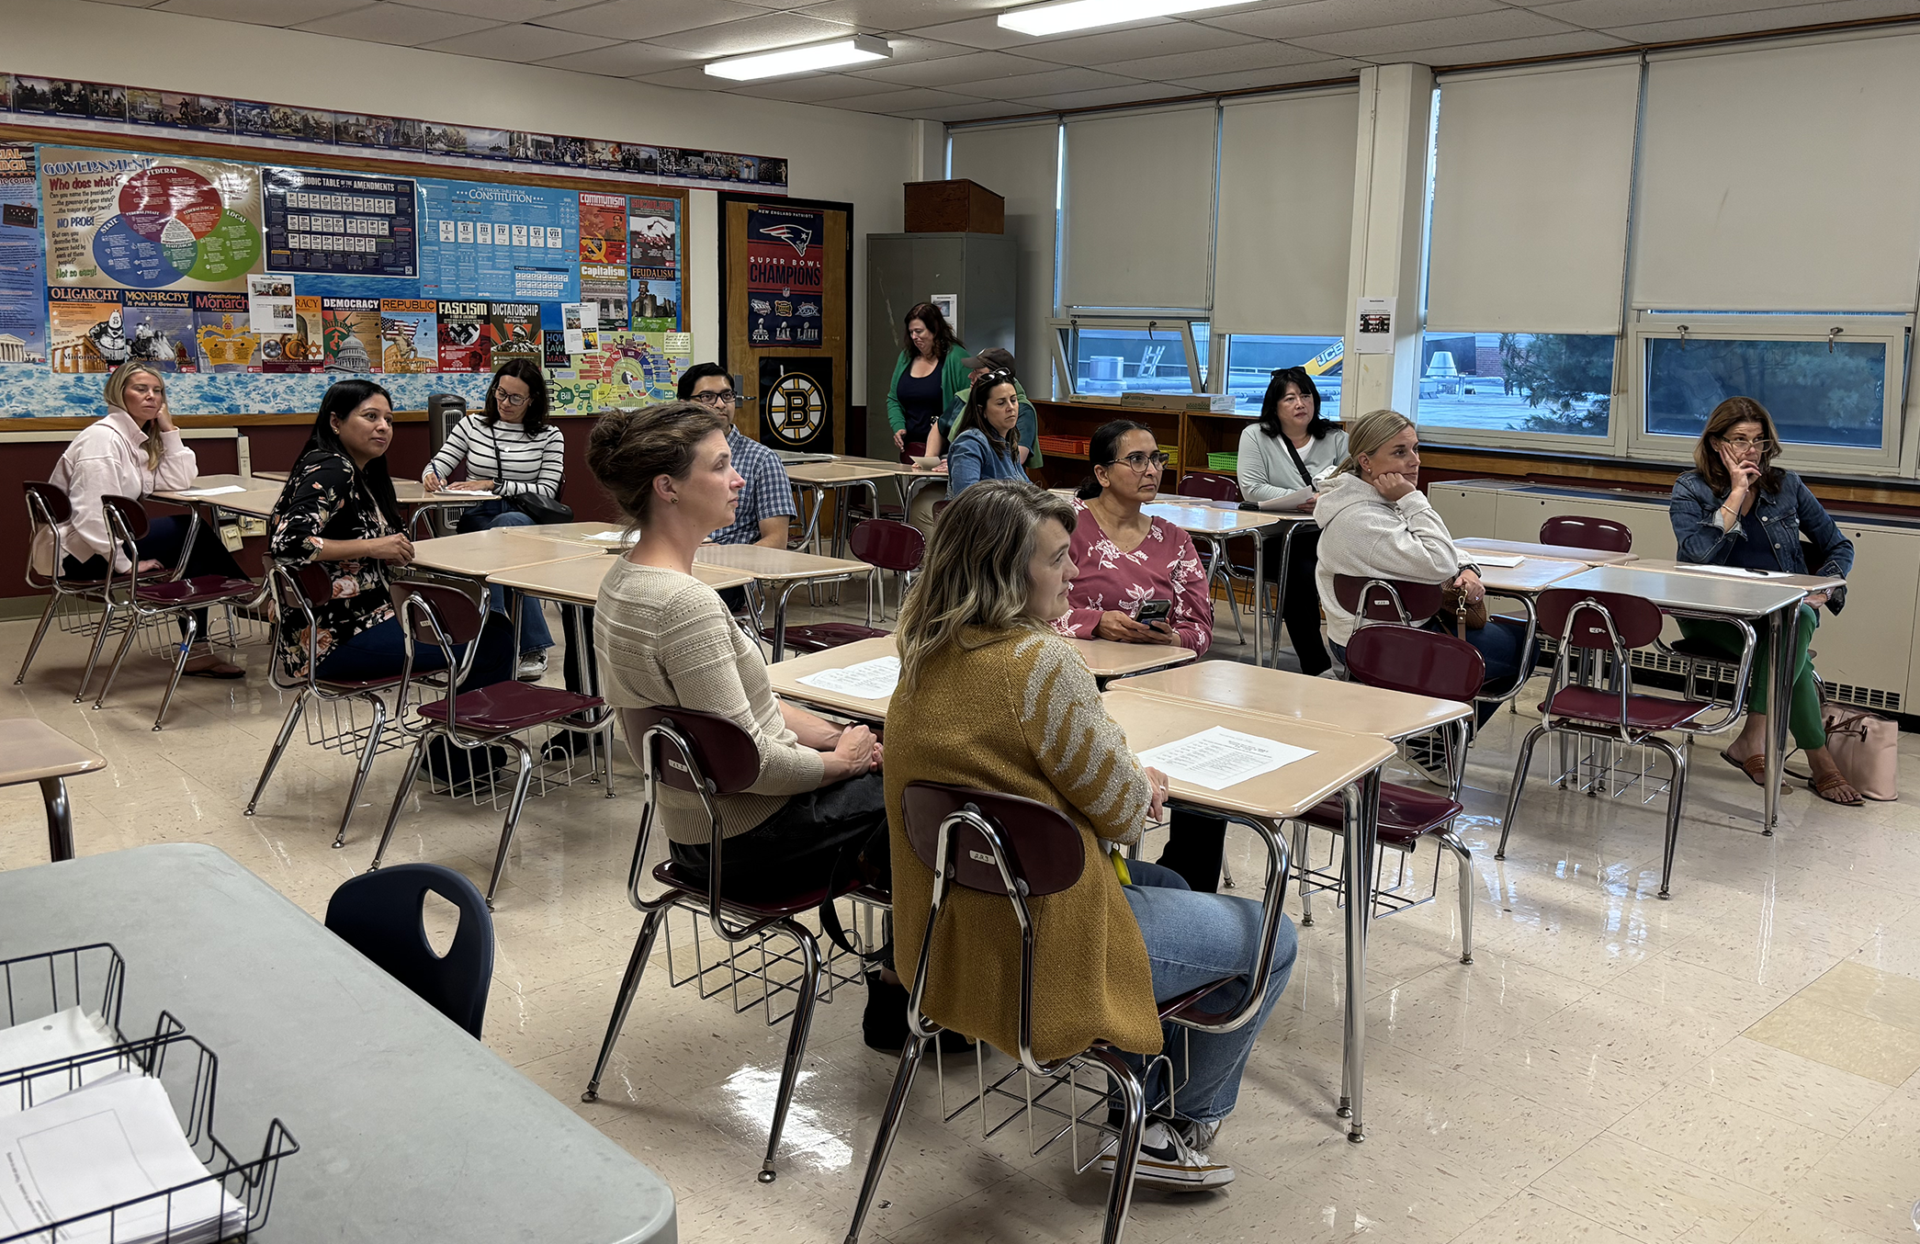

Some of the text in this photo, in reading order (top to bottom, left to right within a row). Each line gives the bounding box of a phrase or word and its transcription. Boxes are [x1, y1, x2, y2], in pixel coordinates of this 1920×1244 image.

[43, 158, 154, 176] GOVERNMENT
[146, 167, 179, 176] FEDERAL
[49, 177, 70, 191] Who
[72, 176, 92, 190] does
[322, 178, 340, 188] TABLE
[353, 180, 395, 192] AMENDMENTS
[468, 189, 533, 203] CONSTITUTION
[57, 217, 69, 229] NO
[226, 210, 248, 223] LOCAL
[100, 218, 120, 234] STATE
[750, 256, 821, 267] SUPER BOWL
[581, 265, 625, 278] Capitalism
[632, 268, 674, 278] FEUDALISM
[750, 264, 821, 287] CHAMPIONS
[51, 287, 119, 300] OLIGARCHY
[125, 291, 190, 304] MONARCHY
[196, 295, 250, 309] Monarch
[323, 298, 379, 309] DEMOCRACY
[382, 300, 435, 310] REPUBLIC
[438, 301, 488, 315] FASCISM
[492, 303, 539, 317] DICTATORSHIP
[1316, 340, 1344, 367] JCB
[783, 389, 811, 429] B
